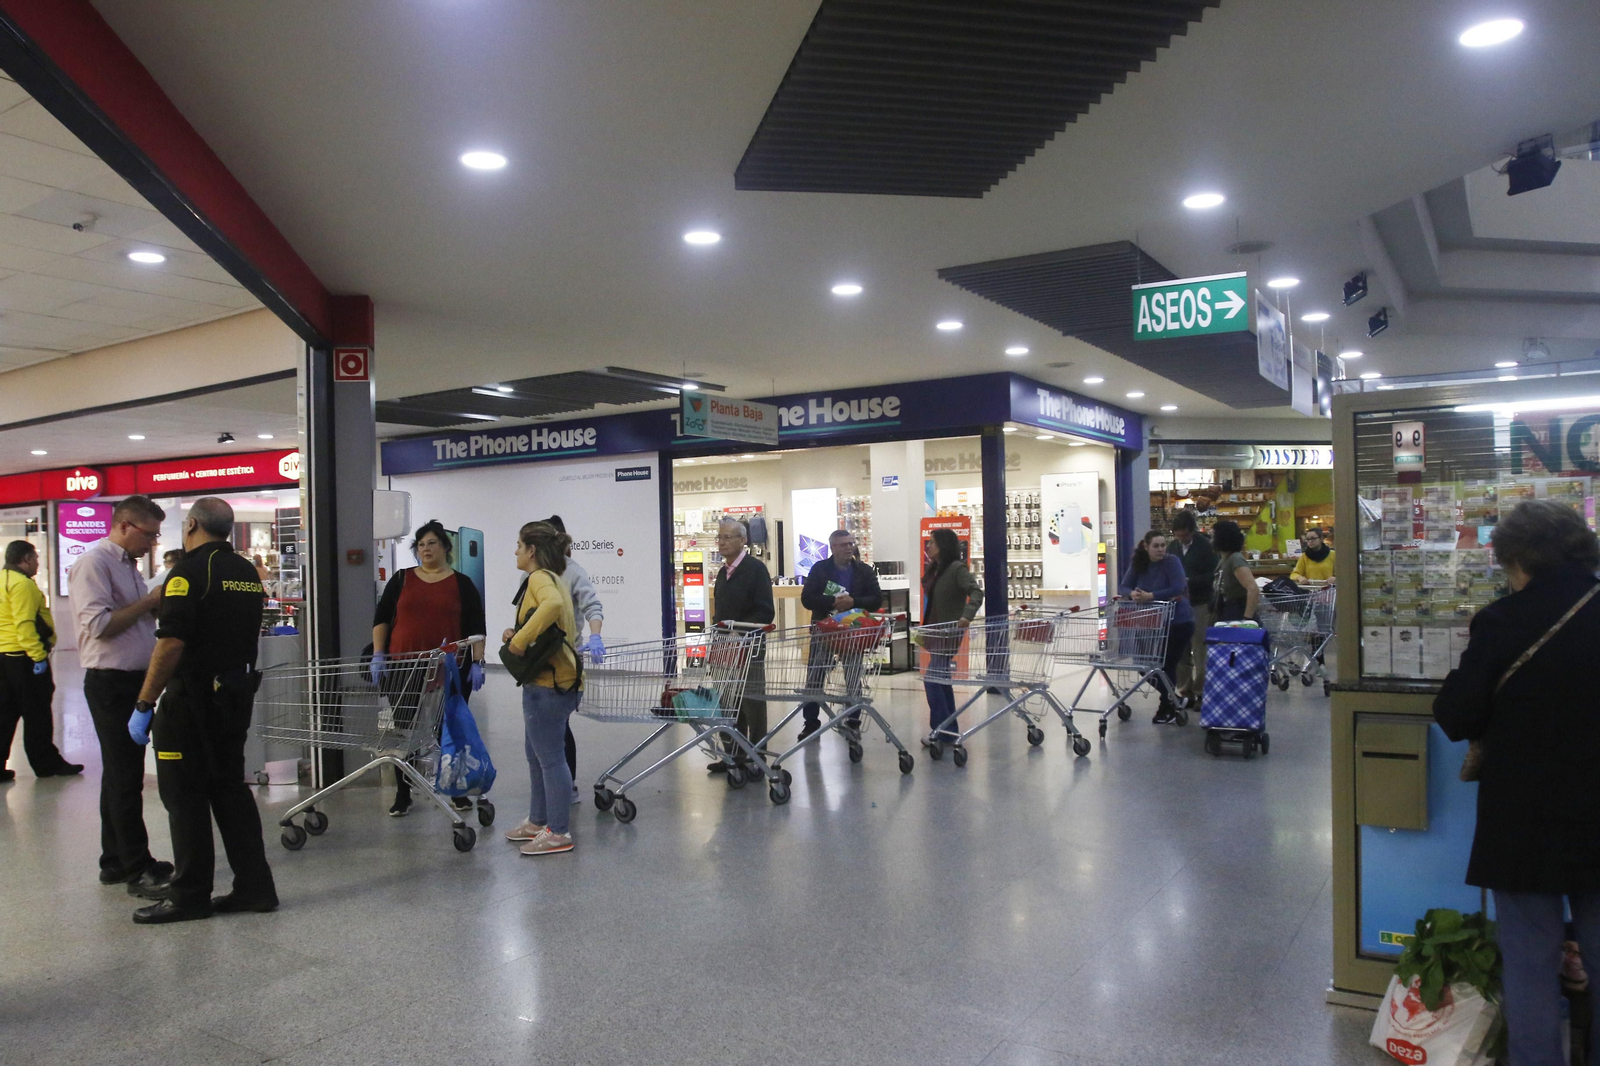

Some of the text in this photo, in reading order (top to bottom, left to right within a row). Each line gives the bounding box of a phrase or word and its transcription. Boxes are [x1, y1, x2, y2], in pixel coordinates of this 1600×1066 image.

[1137, 287, 1212, 333] ASEOS
[710, 400, 740, 417] Planta
[743, 405, 763, 422] Baja
[808, 396, 901, 425] House
[1037, 388, 1125, 435] The Phone House
[432, 427, 597, 460] The Phone House
[924, 457, 957, 473] one
[1258, 449, 1320, 466] MASTER
[152, 471, 190, 482] PERFUMERÍA
[195, 469, 218, 479] CENTRO
[218, 468, 227, 477] DE
[703, 476, 748, 490] House
[66, 520, 106, 528] GRANDES
[569, 539, 614, 551] ate20 Series
[588, 575, 625, 585] ÁS PODER
